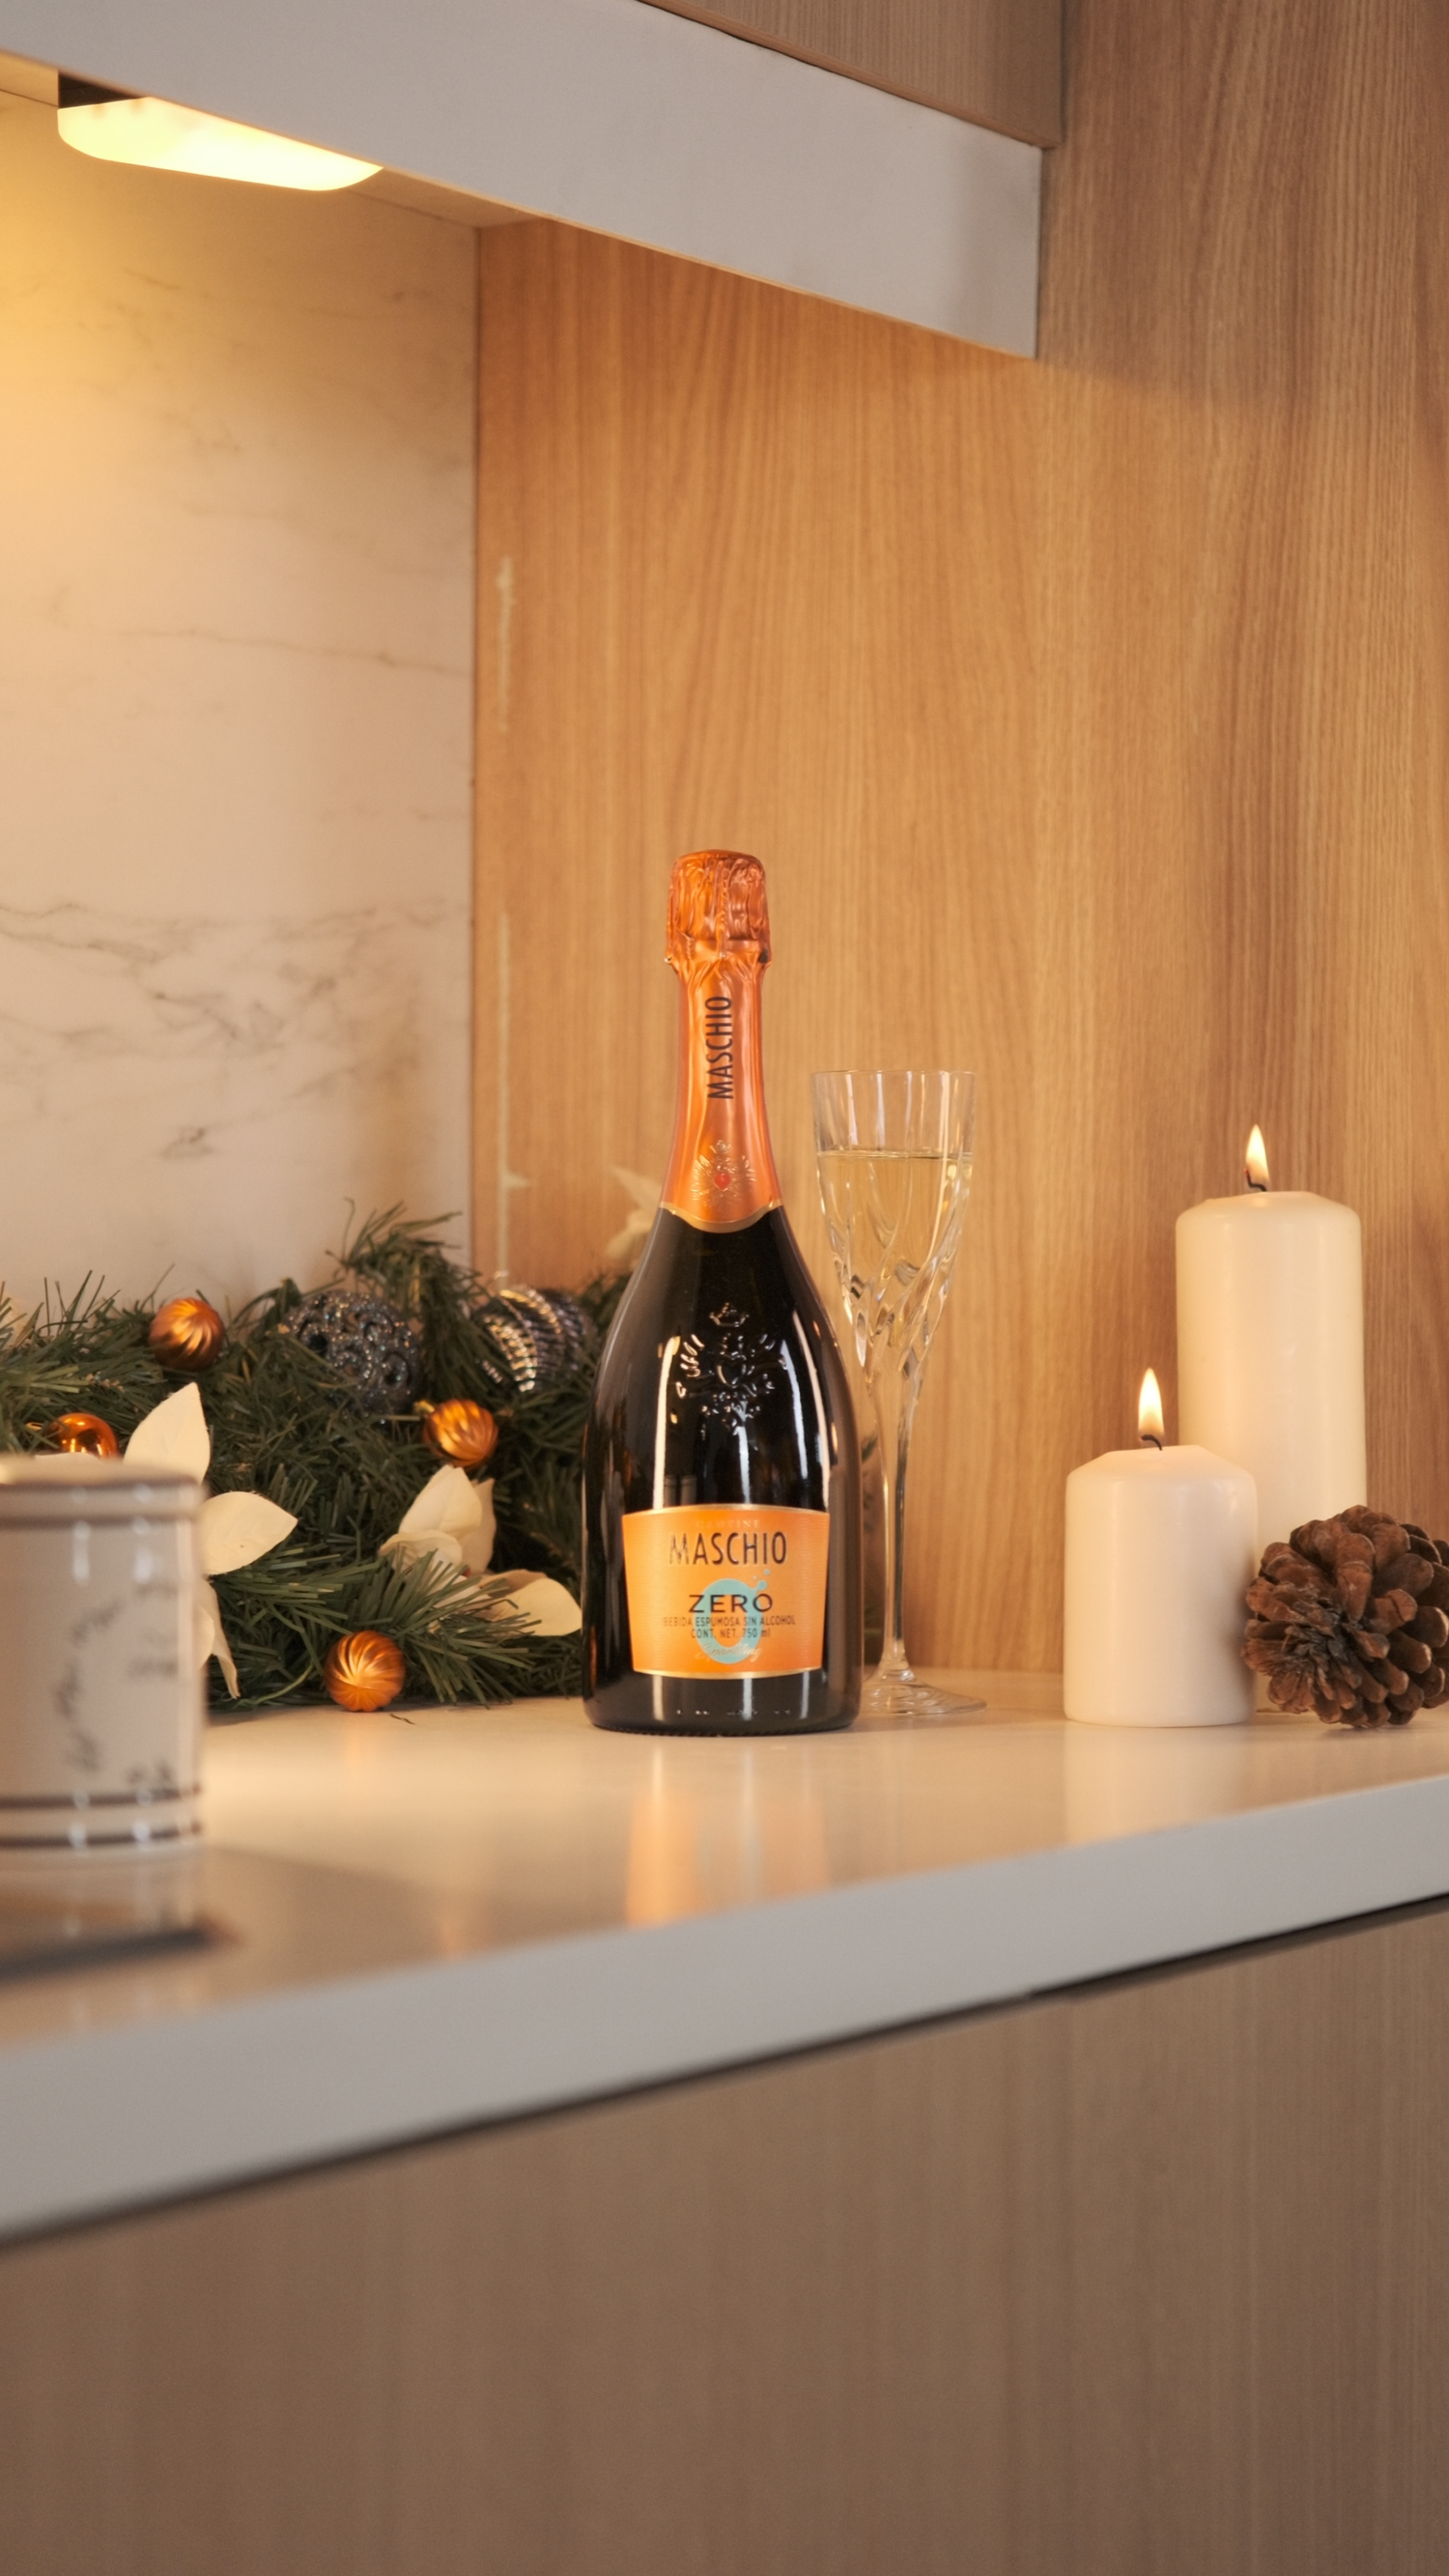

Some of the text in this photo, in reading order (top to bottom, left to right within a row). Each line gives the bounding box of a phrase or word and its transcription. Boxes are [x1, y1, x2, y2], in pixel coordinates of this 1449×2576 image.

[705, 996, 734, 1099] MASCHIO
[668, 1531, 787, 1565] MASCHIO
[688, 1593, 774, 1613] ZERO
[664, 1615, 796, 1627] BEBIDA ESPUMOSA SIN ALCOHOL
[742, 1628, 757, 1638] 750
